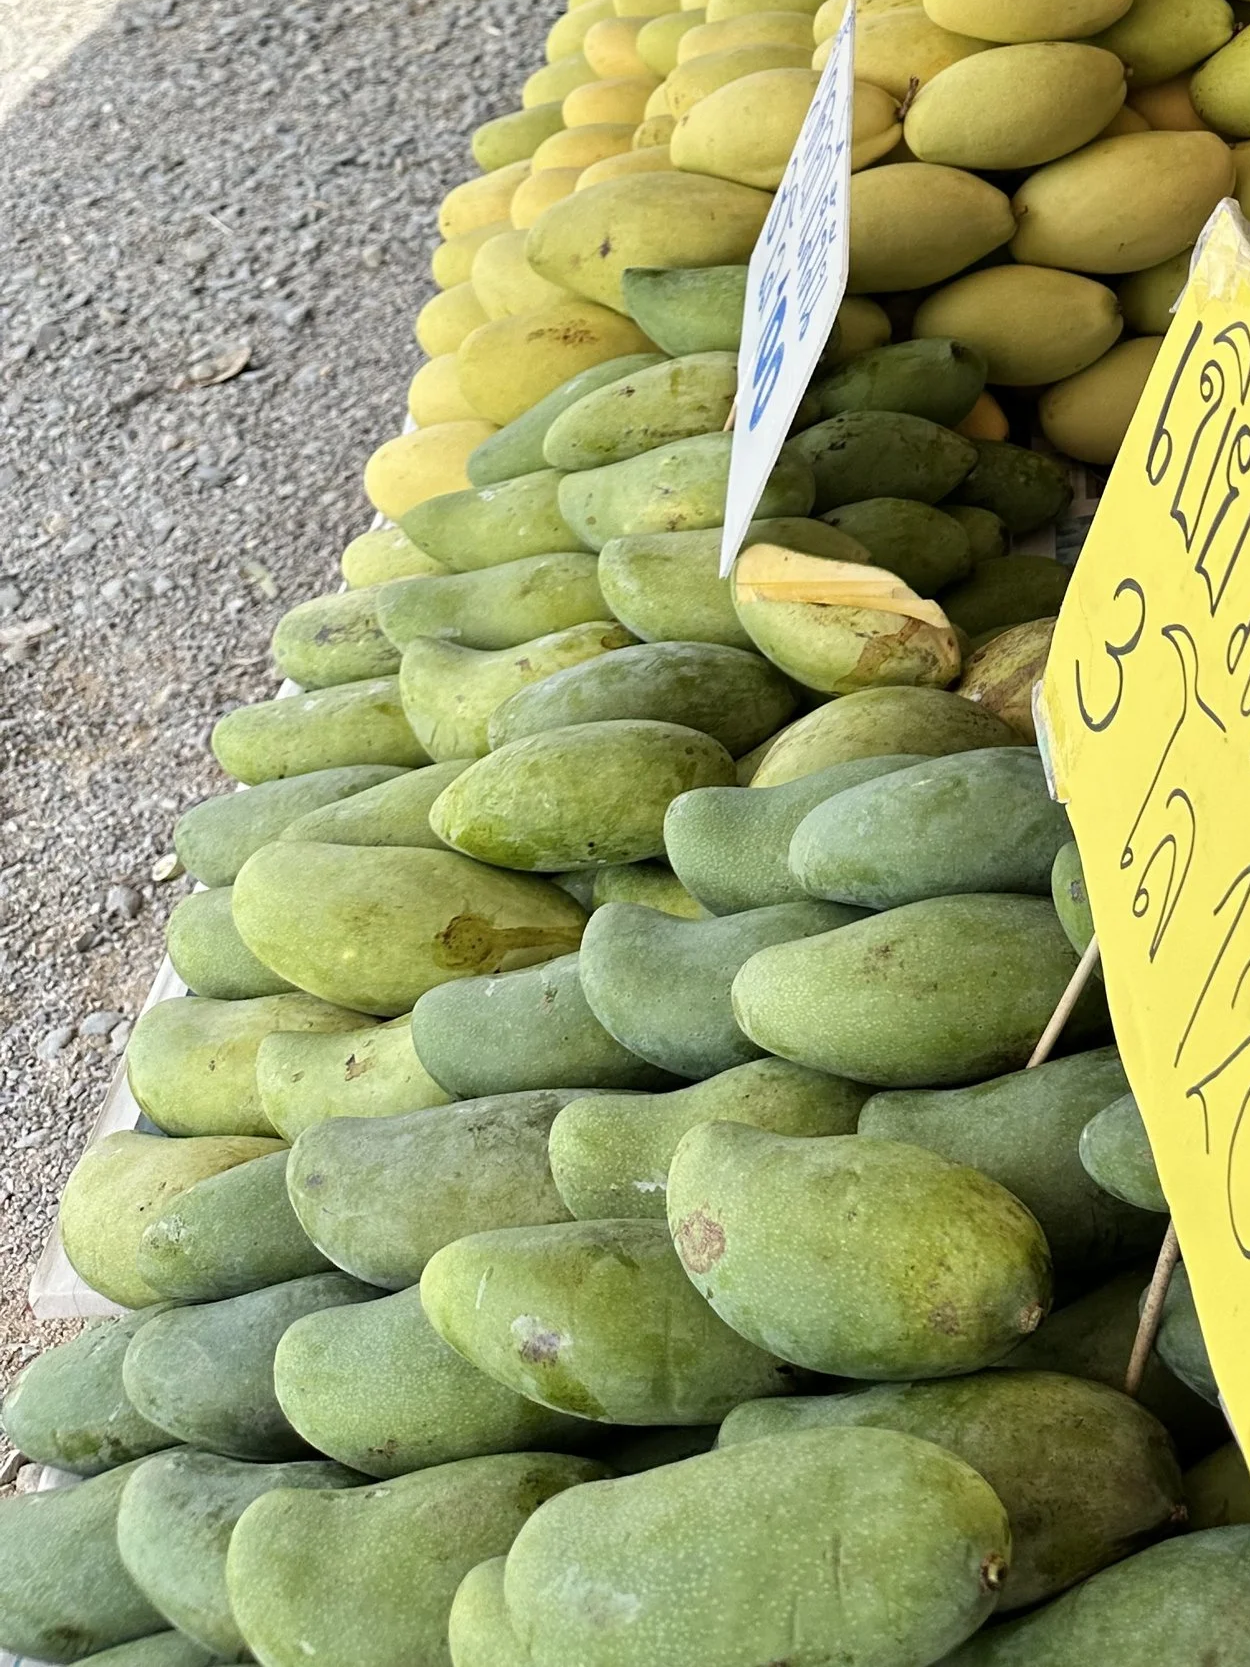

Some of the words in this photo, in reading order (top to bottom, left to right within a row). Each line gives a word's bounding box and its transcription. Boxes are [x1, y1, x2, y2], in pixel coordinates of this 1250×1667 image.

[749, 268, 792, 432] 100
[1075, 578, 1146, 733] 3
[1120, 623, 1227, 964] โล
